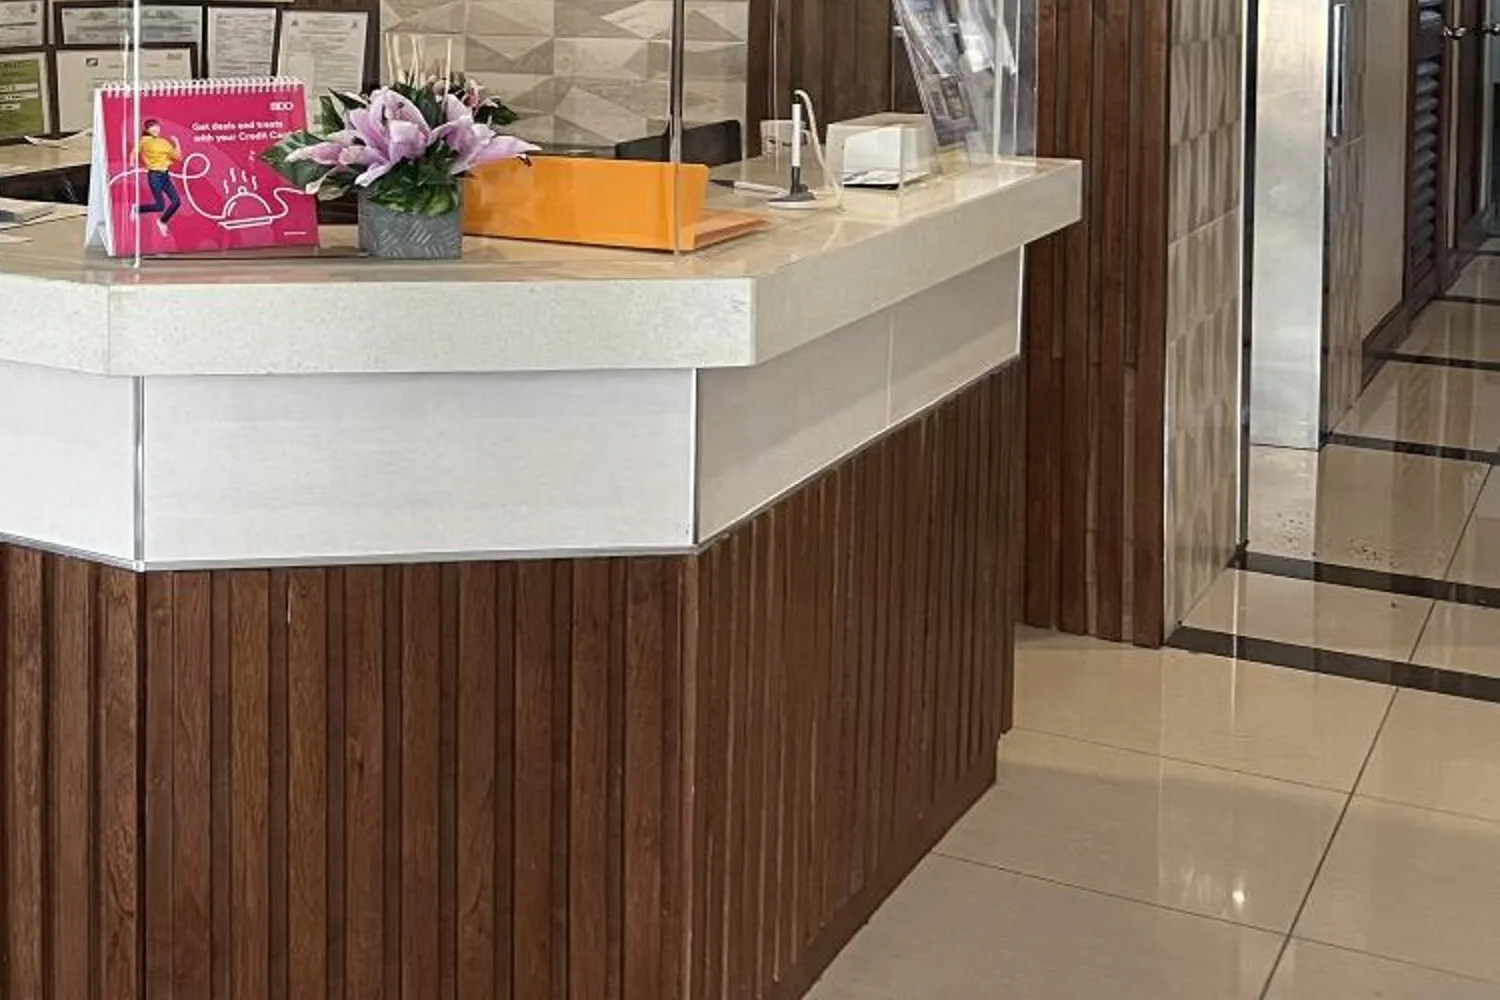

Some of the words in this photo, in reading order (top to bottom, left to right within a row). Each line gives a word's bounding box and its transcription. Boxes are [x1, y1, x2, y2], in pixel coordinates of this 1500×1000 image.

[191, 123, 210, 131] Get
[211, 122, 235, 130] deals
[238, 122, 255, 130] and
[256, 121, 283, 129] treats
[194, 134, 215, 142] with
[216, 134, 236, 143] your
[238, 131, 267, 141] Credit
